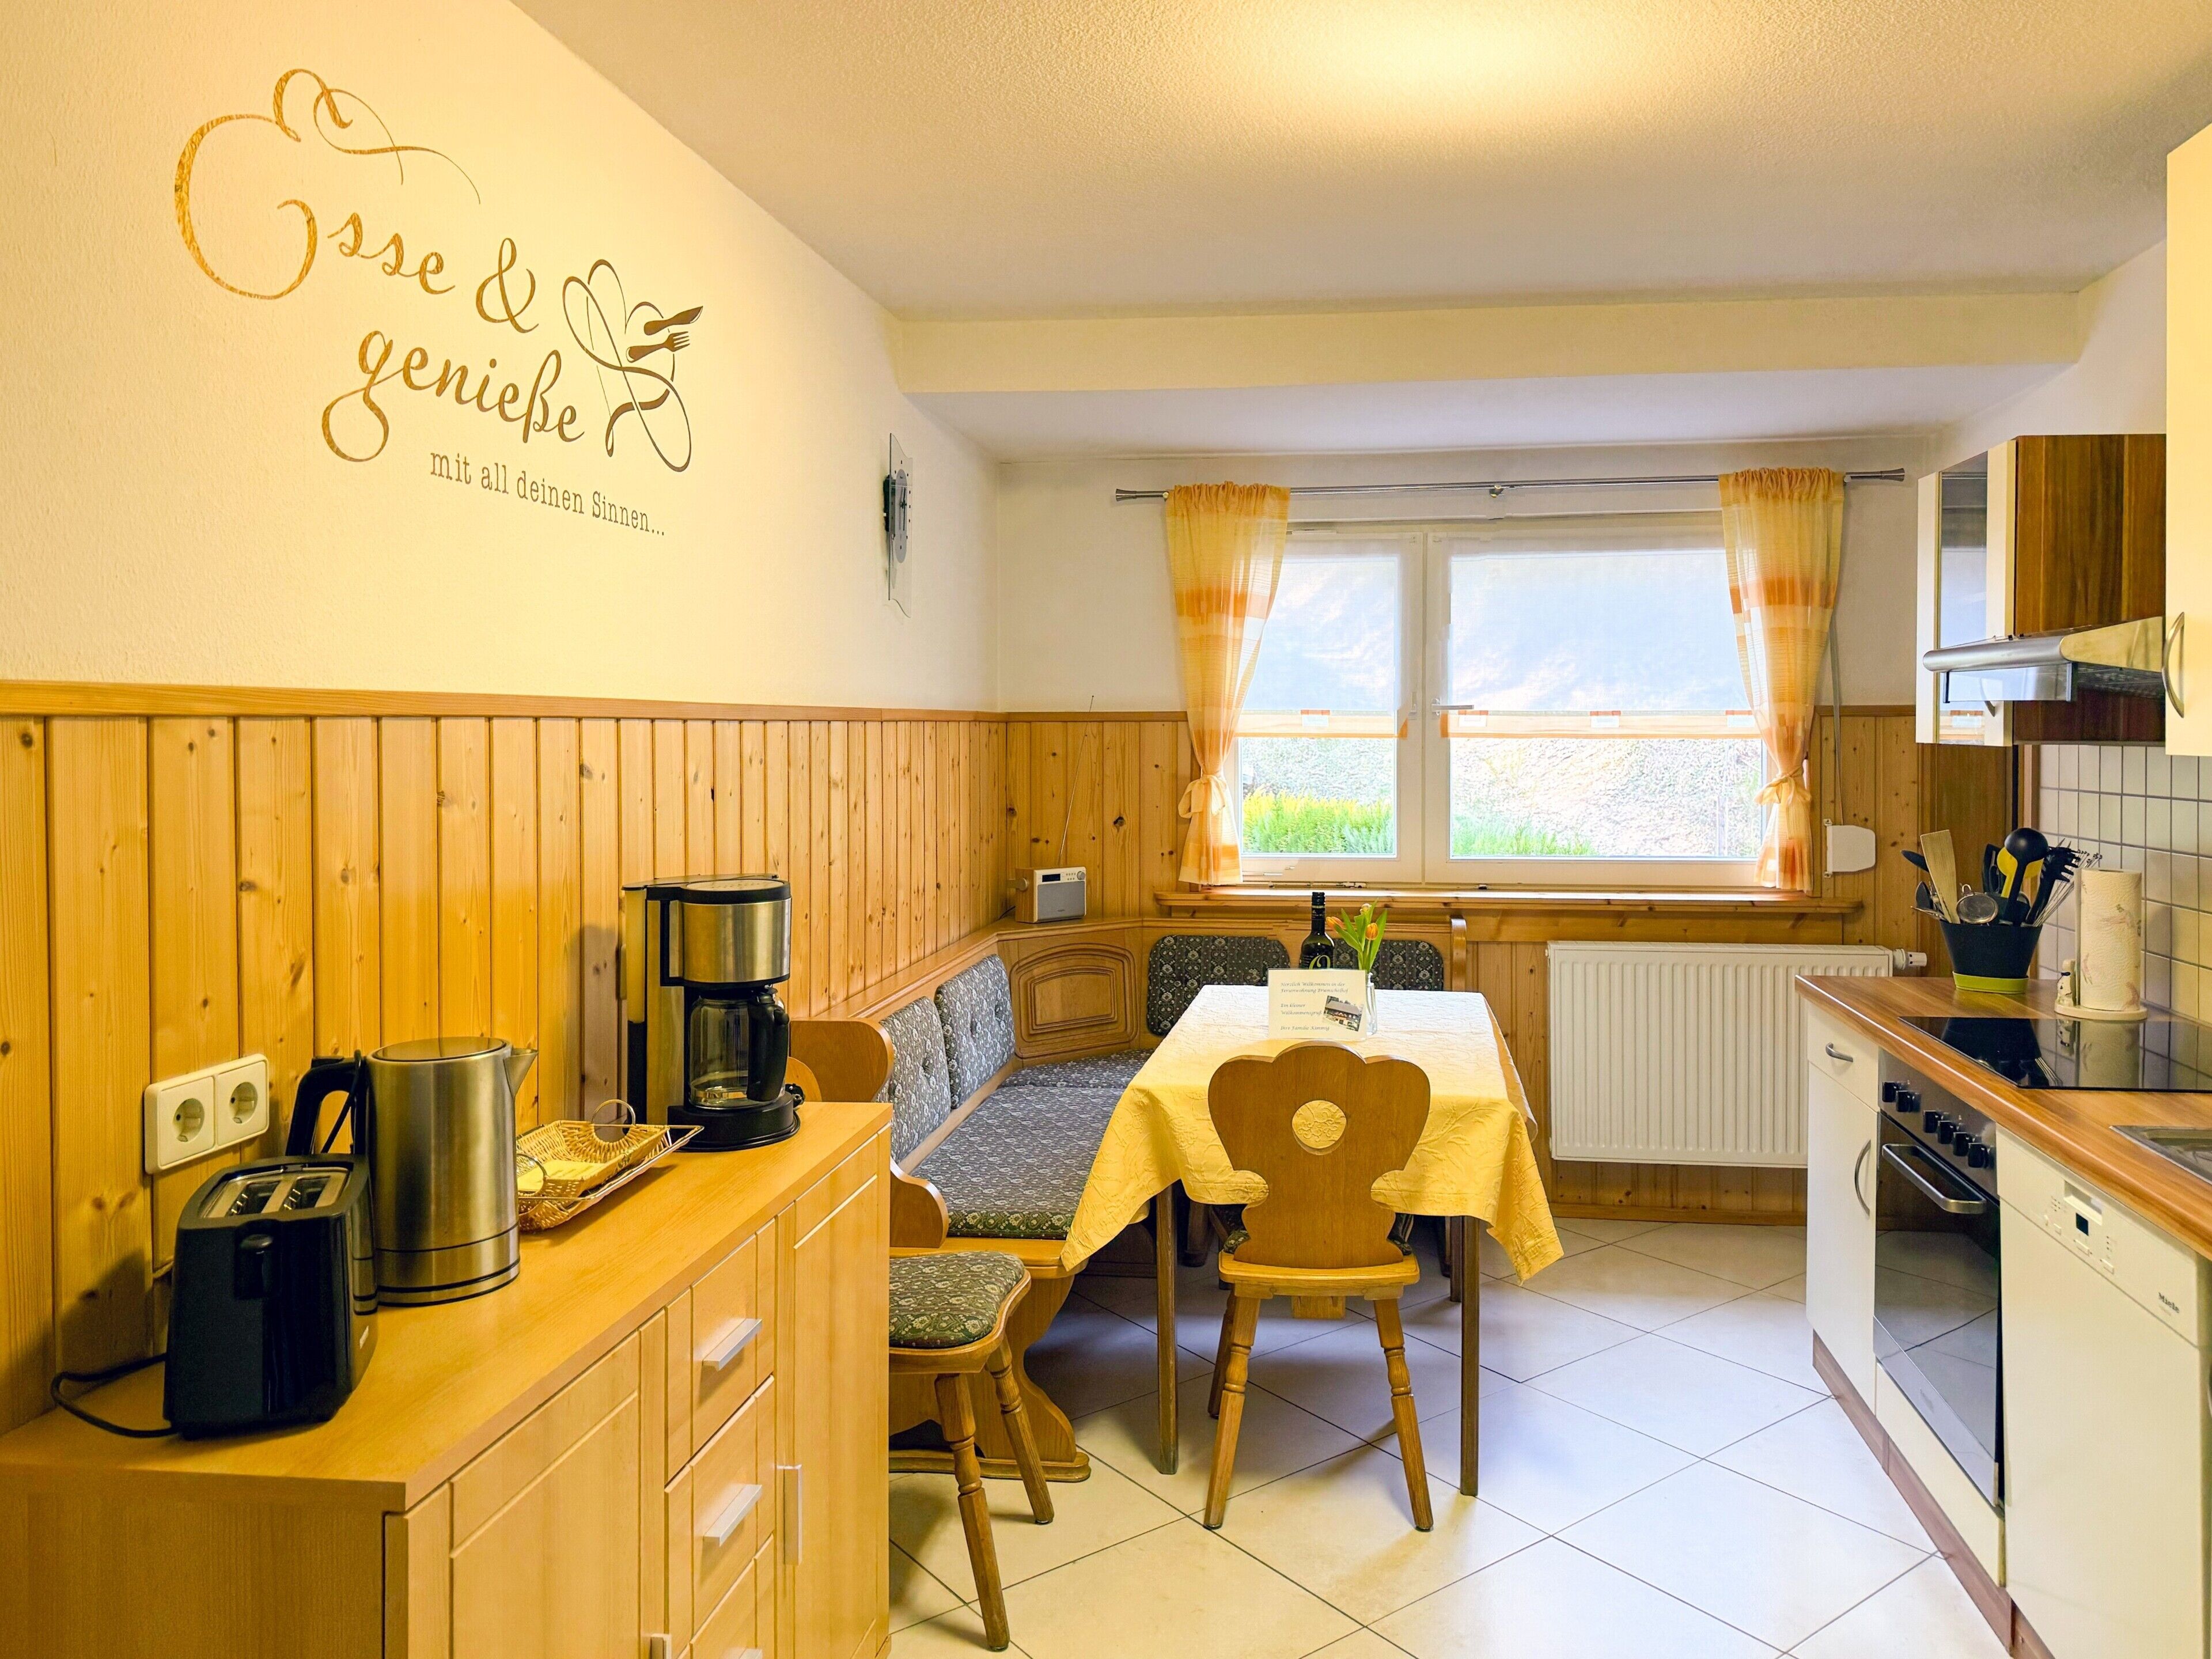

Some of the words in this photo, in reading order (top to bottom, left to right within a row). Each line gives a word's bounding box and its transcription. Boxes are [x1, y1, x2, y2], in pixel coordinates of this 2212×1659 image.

[175, 68, 480, 300] Esse
[476, 237, 539, 334] &
[321, 330, 585, 462] genieße
[430, 452, 472, 484] mit
[481, 463, 509, 495] all
[517, 470, 585, 514] deinen
[592, 491, 664, 536] Sinnen...
[2158, 1291, 2180, 1314] Miele
